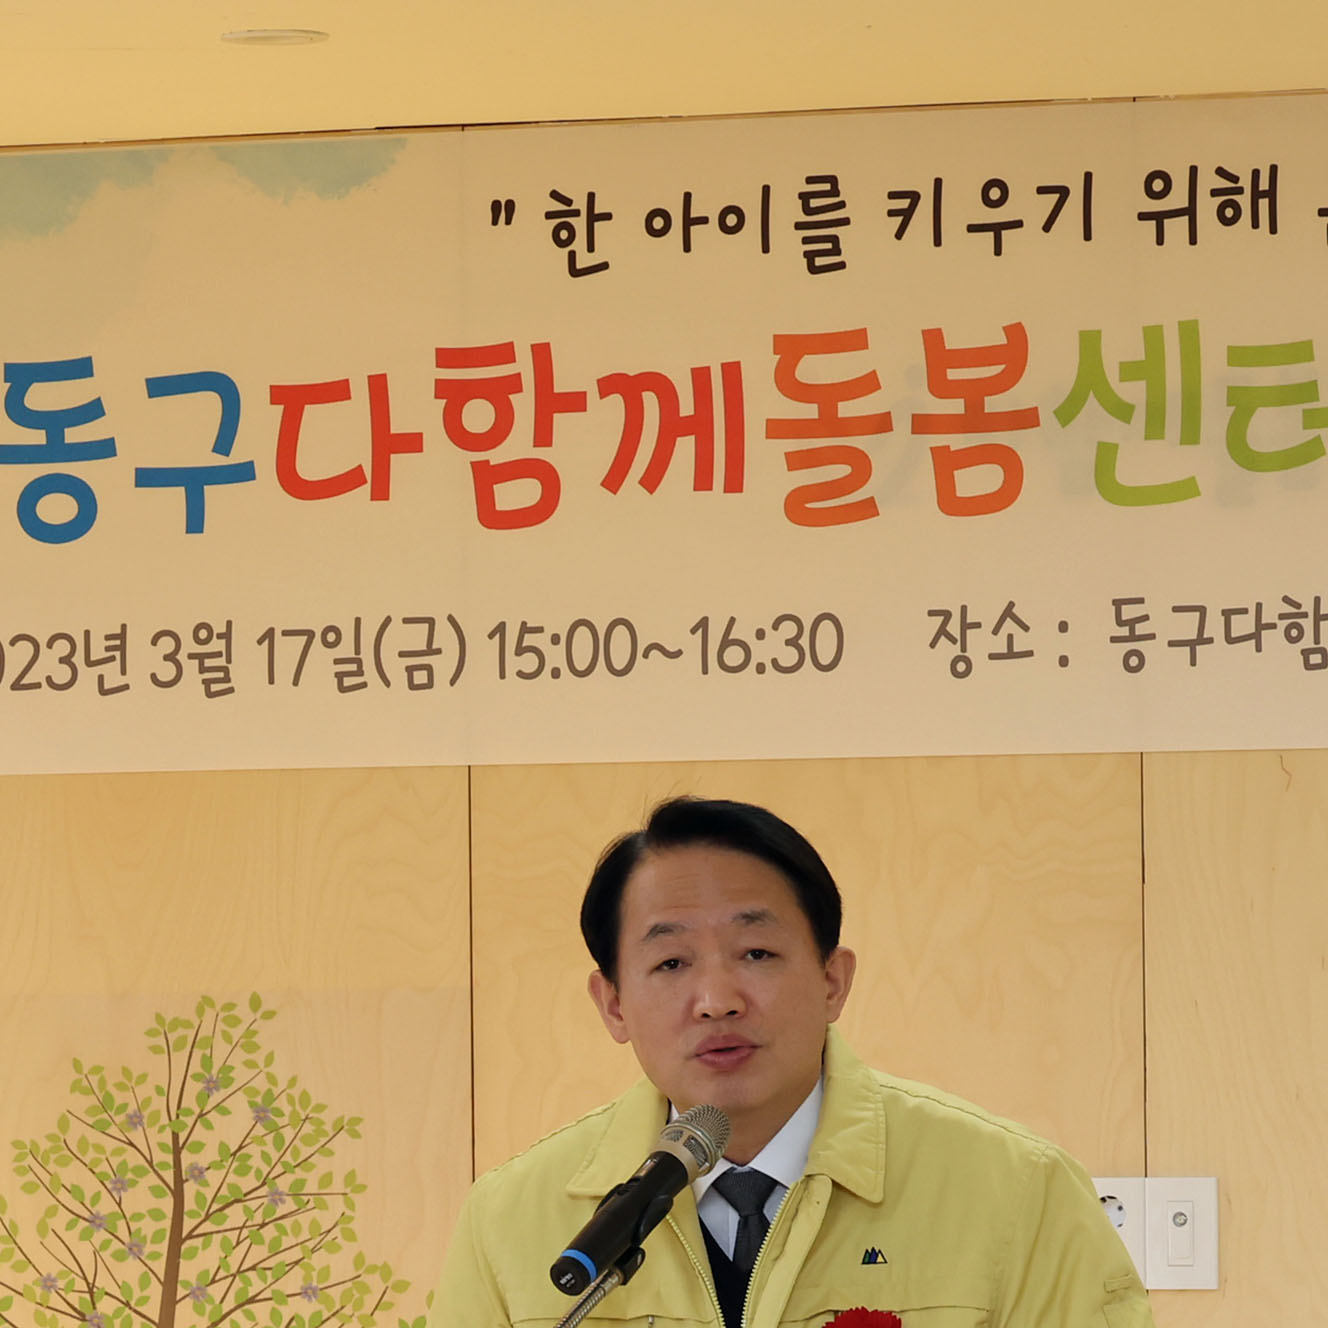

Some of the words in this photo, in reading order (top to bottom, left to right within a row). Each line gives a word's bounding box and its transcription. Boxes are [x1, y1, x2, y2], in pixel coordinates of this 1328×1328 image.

[543, 188, 614, 280] 한
[643, 173, 852, 276] 아이를
[885, 176, 1094, 258] 키우기
[1135, 162, 1280, 248] 위해
[148, 618, 236, 700] 3월
[254, 613, 468, 695] 17일(금)
[485, 610, 846, 683] 15:00~16:30
